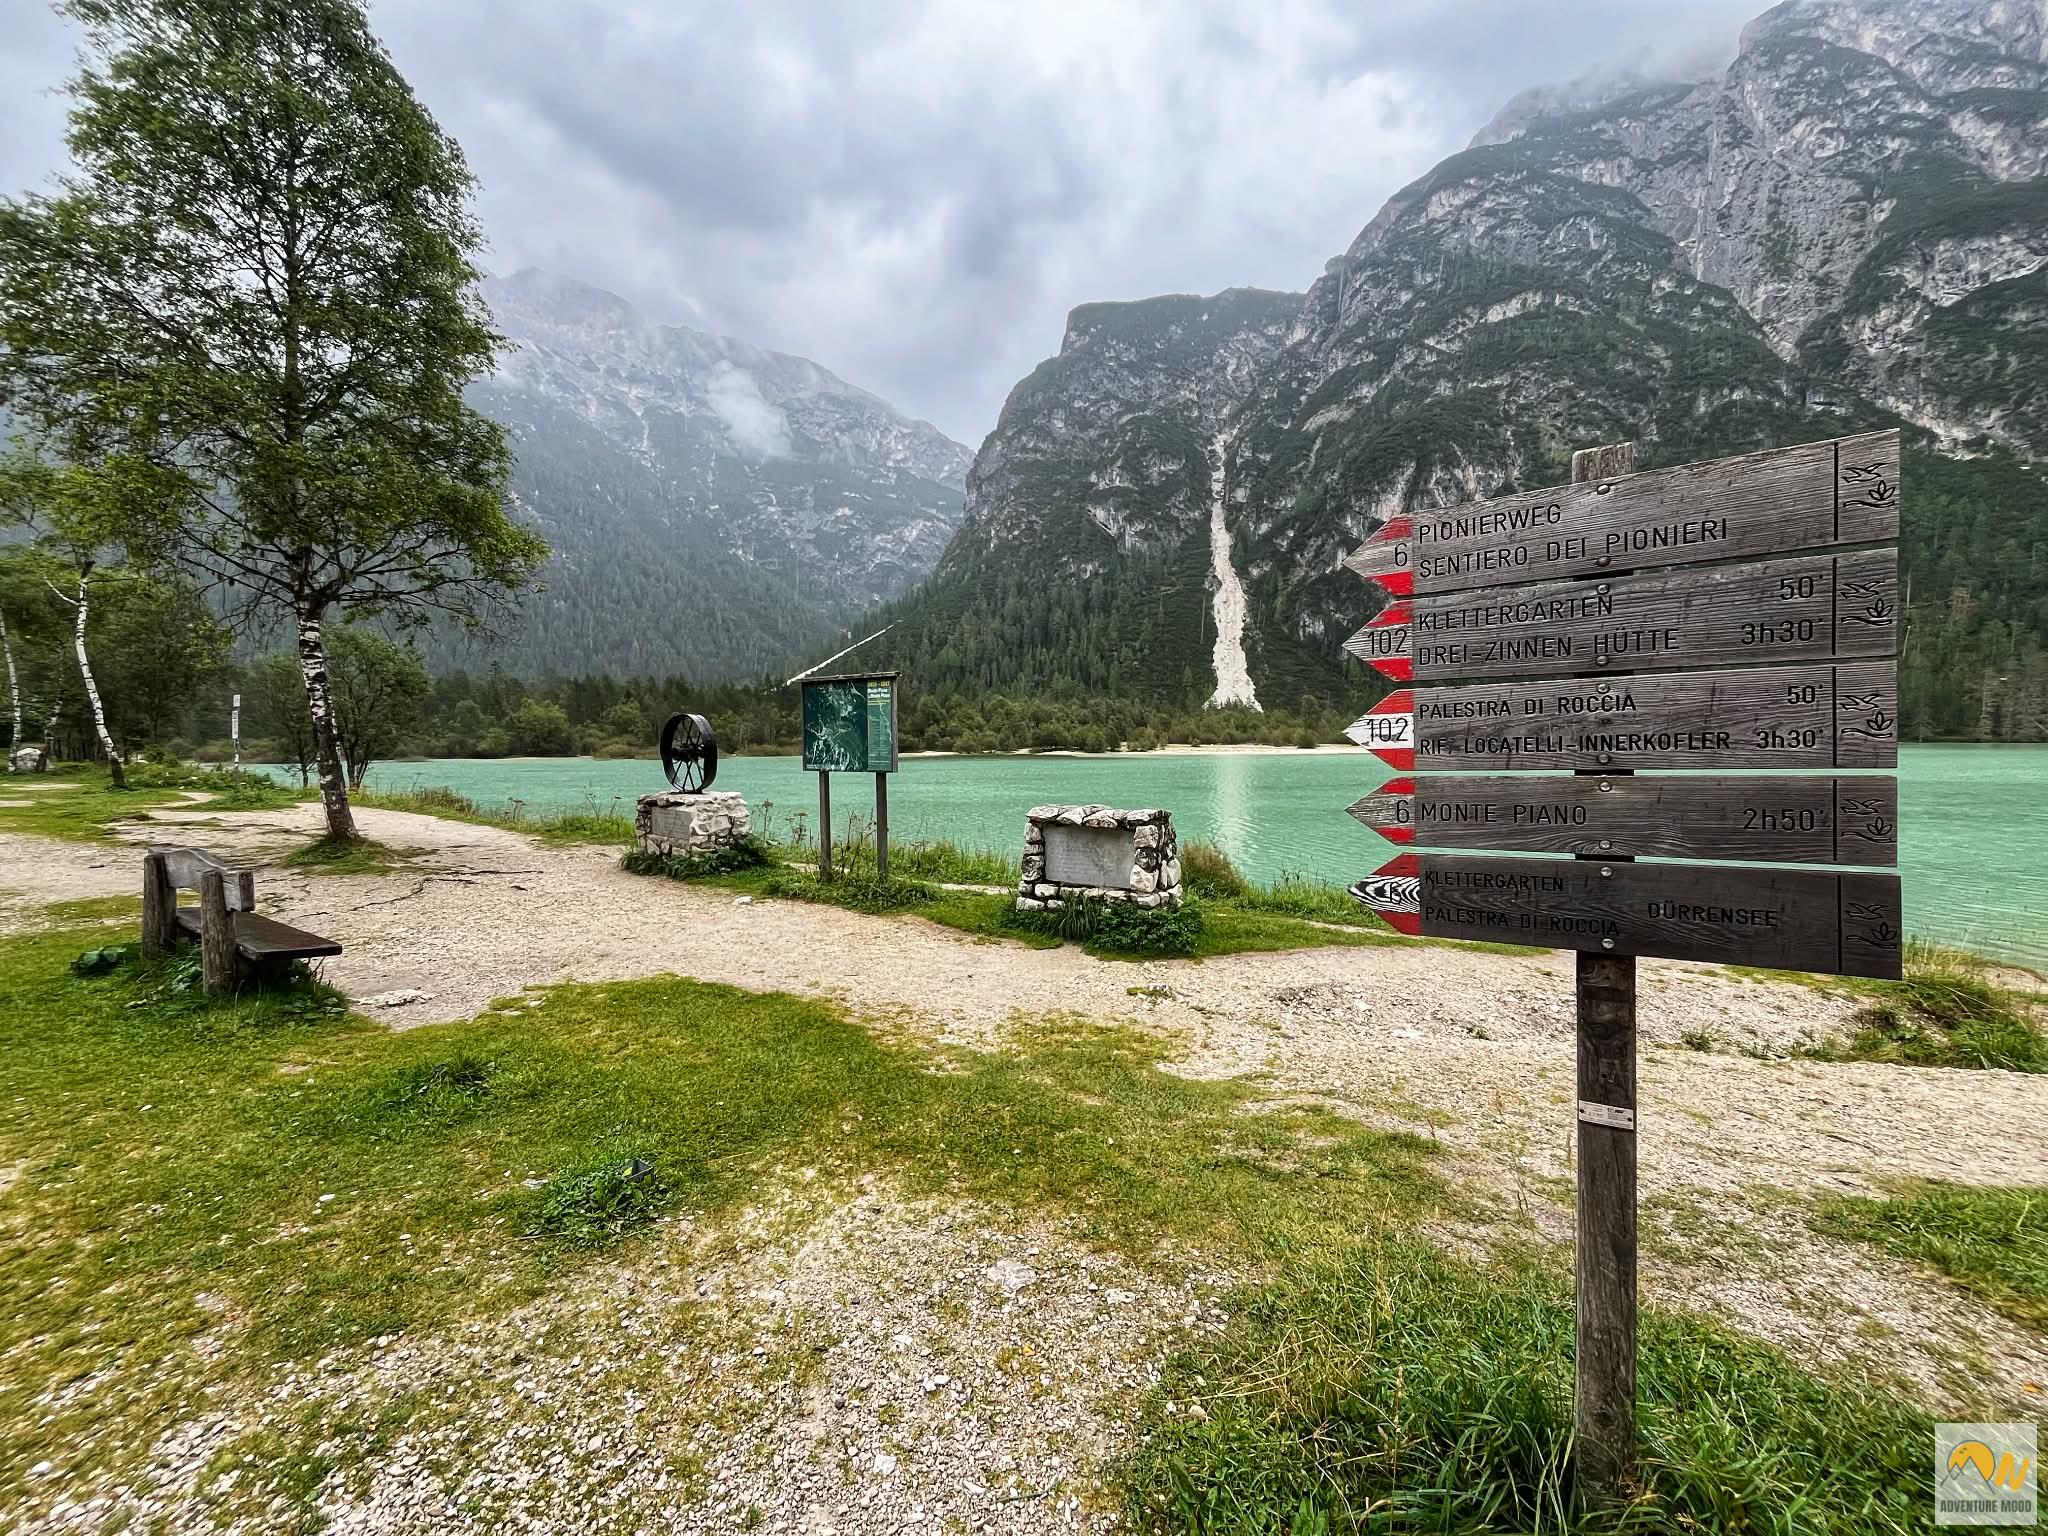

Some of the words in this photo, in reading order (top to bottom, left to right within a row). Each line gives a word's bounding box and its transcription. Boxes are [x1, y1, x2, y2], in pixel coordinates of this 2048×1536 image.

[1419, 504, 1561, 544] PIONIERWEG
[1394, 543, 1408, 567] 6
[1419, 546, 1528, 578] SENTIERO
[1546, 538, 1586, 562] DEI
[1606, 518, 1727, 554] PIONIERI
[1419, 595, 1613, 631] KLETTERGARTEN
[1367, 629, 1408, 655] 102
[1419, 700, 1512, 720] PALESTRA
[1524, 699, 1543, 715] DI
[1558, 694, 1637, 713] ROCCIA
[1367, 717, 1408, 742] 102
[1396, 799, 1410, 823] 6
[1421, 803, 1497, 822] MONTE
[1513, 804, 1587, 825] PIANO
[1425, 870, 1563, 892] KLETTERGARTEN
[1426, 907, 1508, 927] PALESTRA
[1521, 914, 1537, 929] DI
[1551, 916, 1620, 937] ROCCIA
[1648, 901, 1778, 928] DÜRRENSEE
